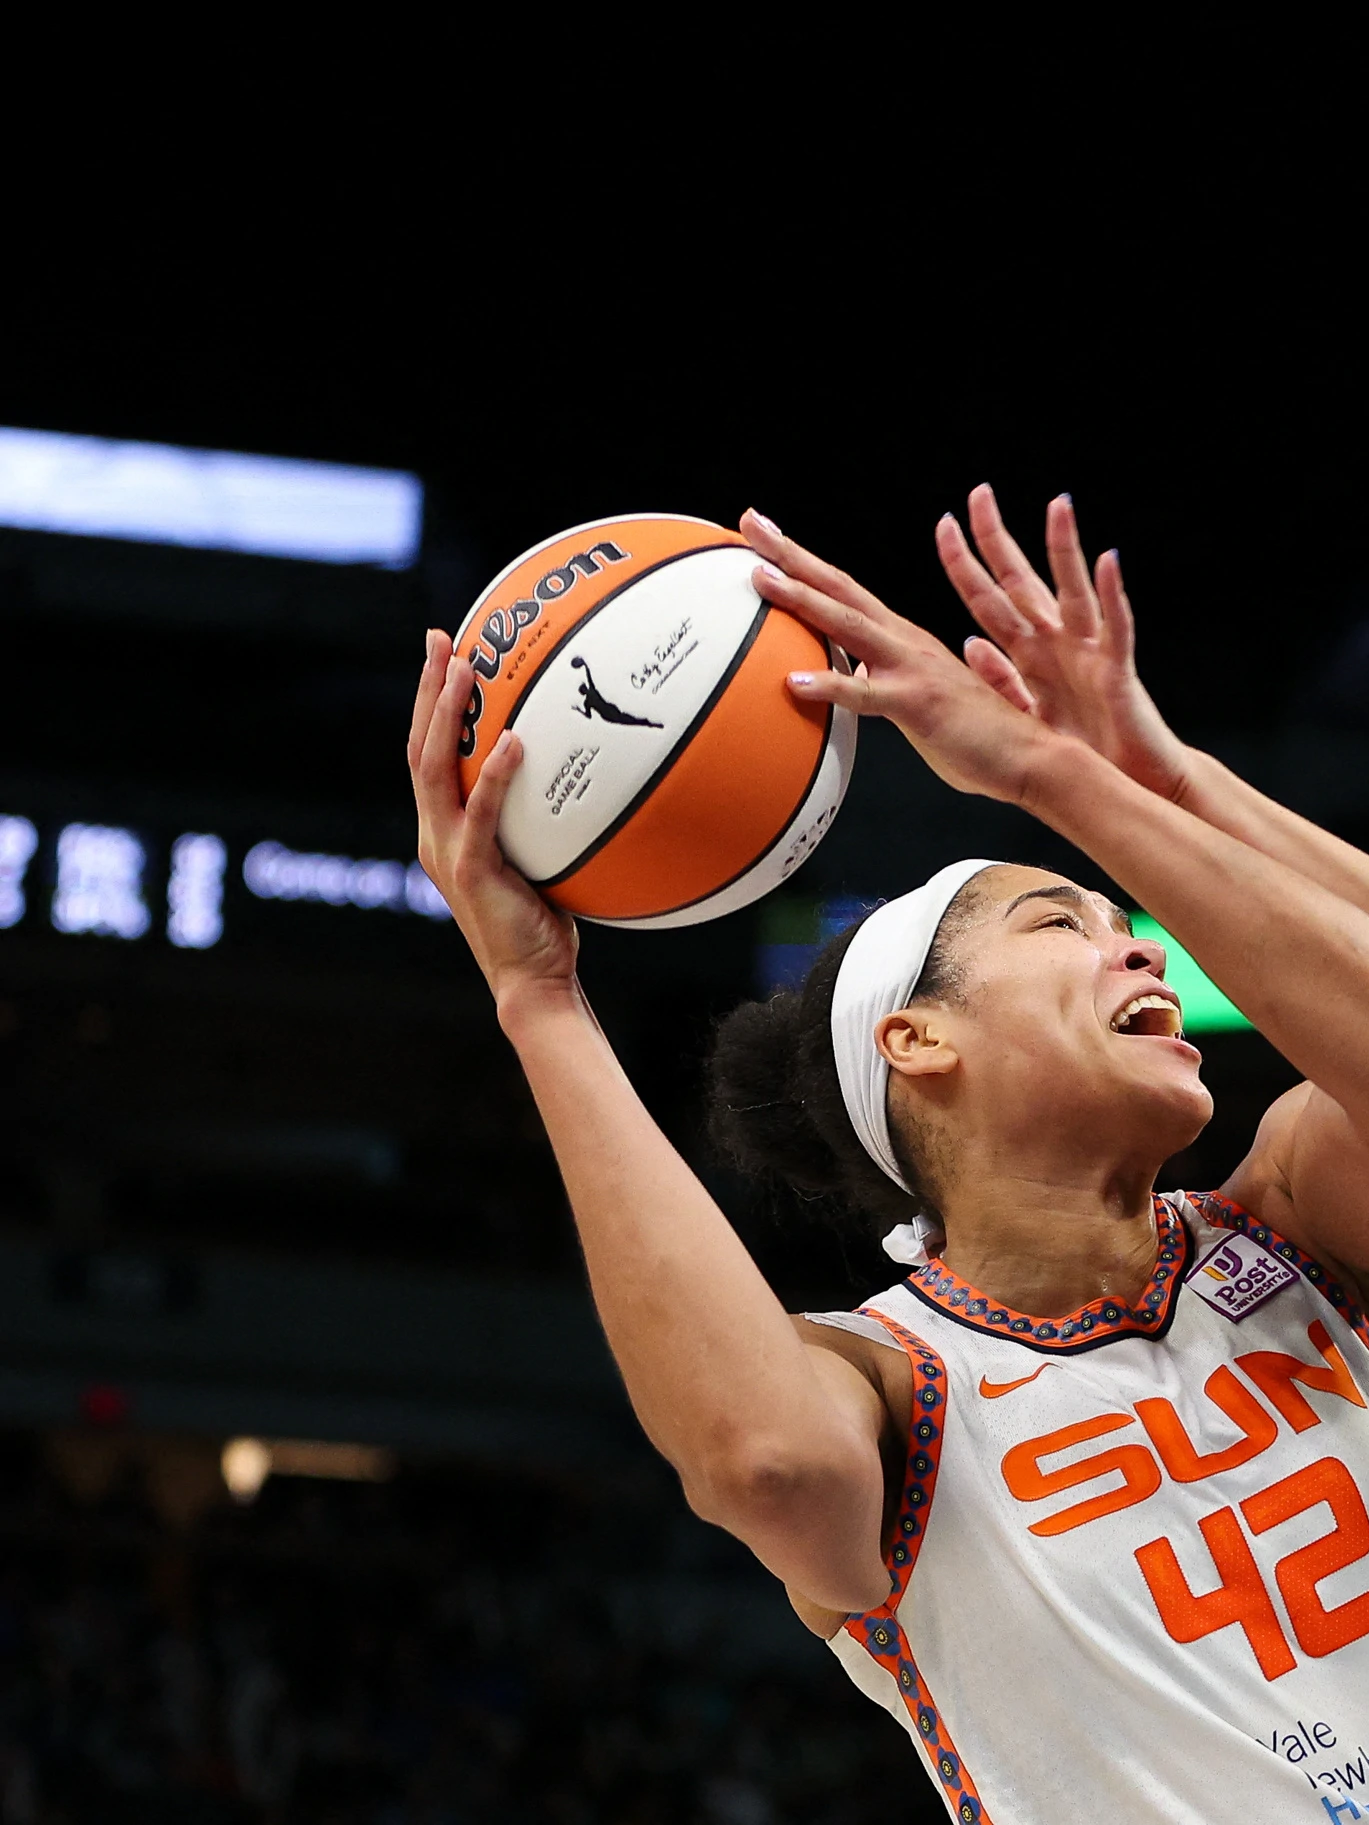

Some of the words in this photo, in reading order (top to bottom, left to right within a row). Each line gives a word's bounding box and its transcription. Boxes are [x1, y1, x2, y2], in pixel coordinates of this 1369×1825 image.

[545, 747, 584, 801] OFFICIAL
[551, 778, 577, 816] GAME
[574, 746, 600, 780] BALL
[1214, 1257, 1279, 1306] Post
[1000, 1320, 1368, 1538] SUN
